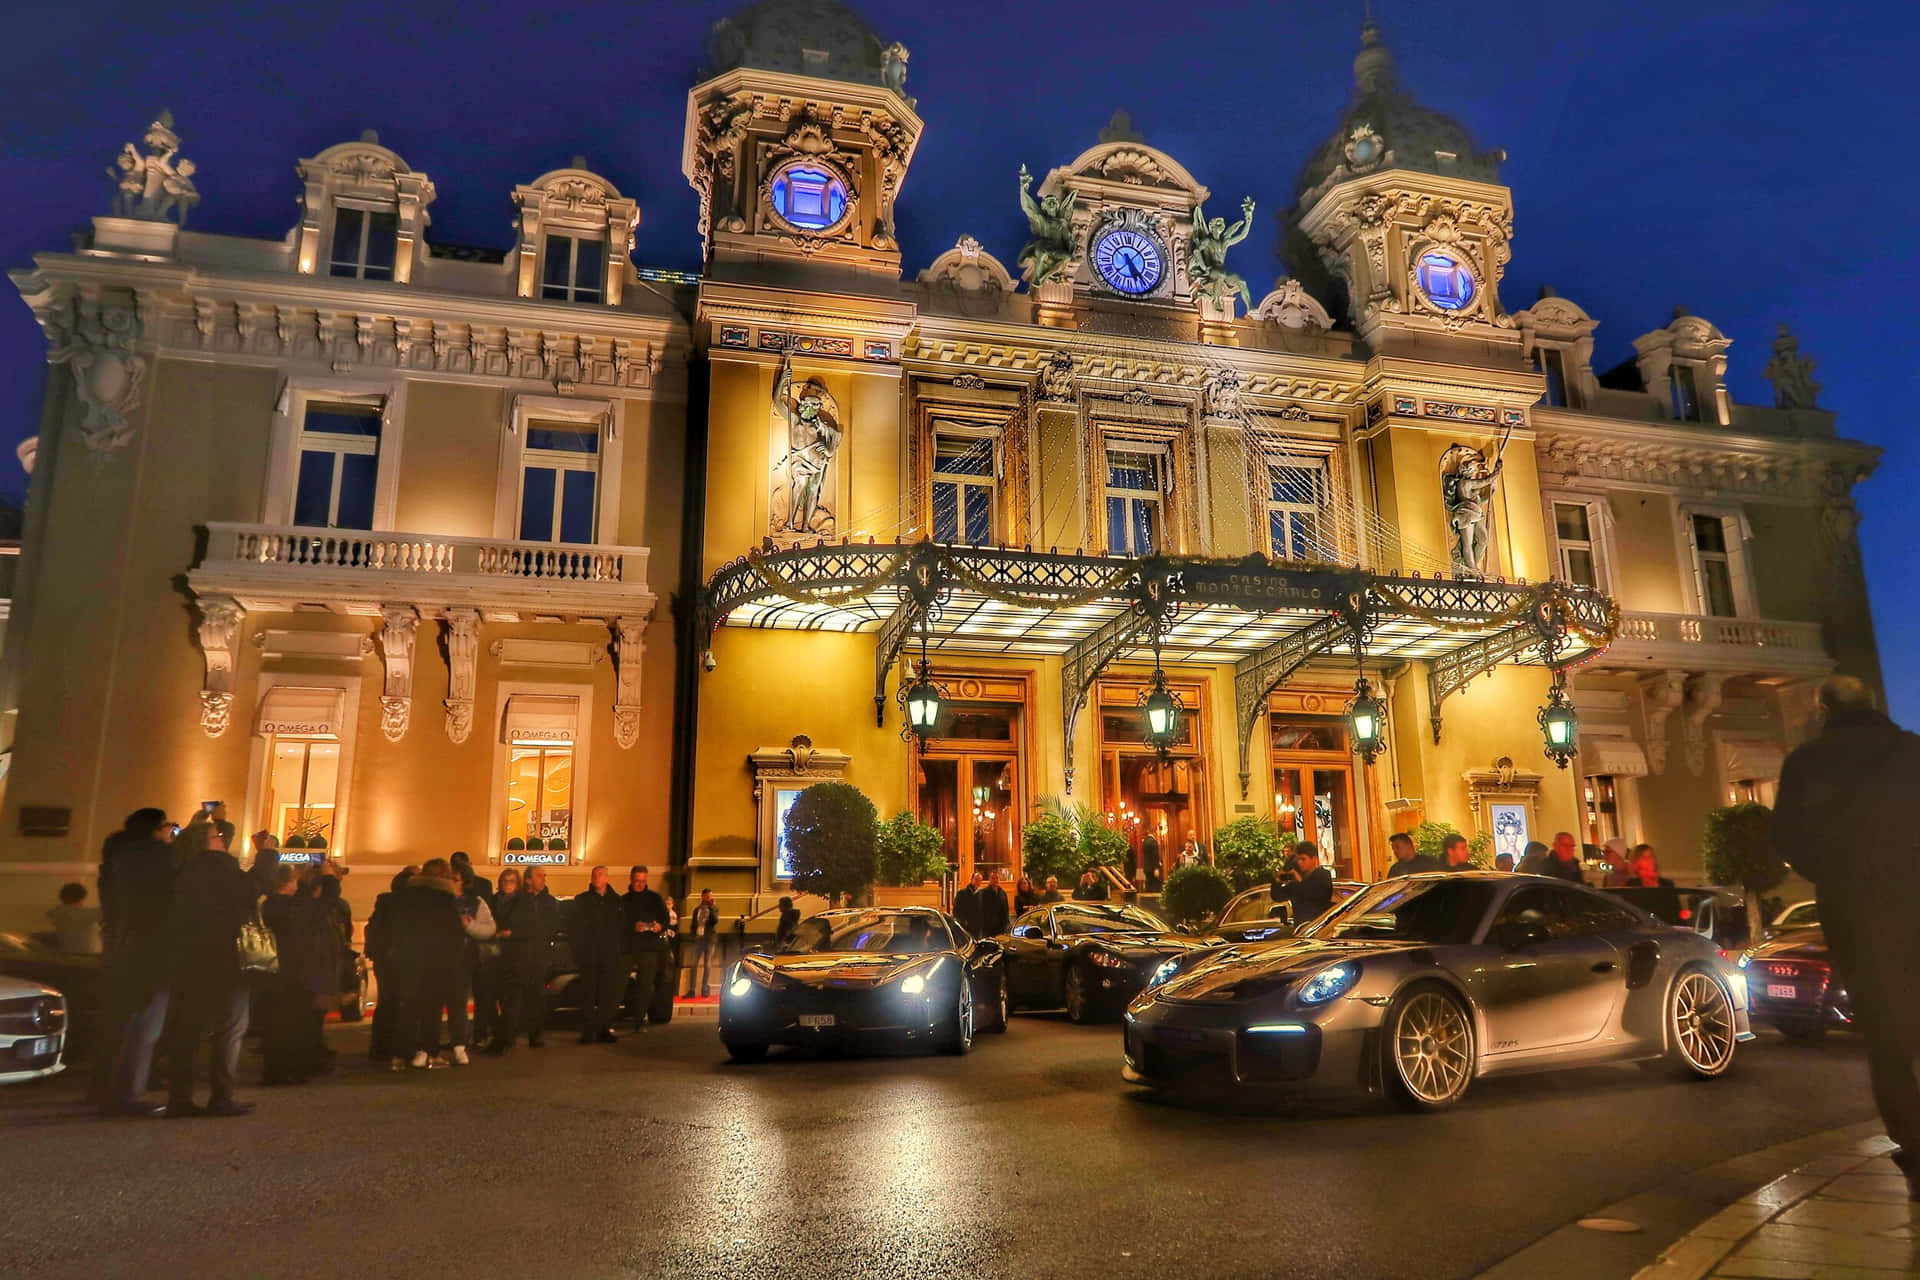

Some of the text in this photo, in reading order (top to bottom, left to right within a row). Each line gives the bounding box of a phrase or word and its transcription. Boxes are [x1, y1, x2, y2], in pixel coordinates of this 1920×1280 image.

[278, 724, 315, 733] OMEGA
[522, 730, 557, 738] OMEGA
[279, 852, 310, 863] MEGA
[517, 854, 553, 863] OMEGA
